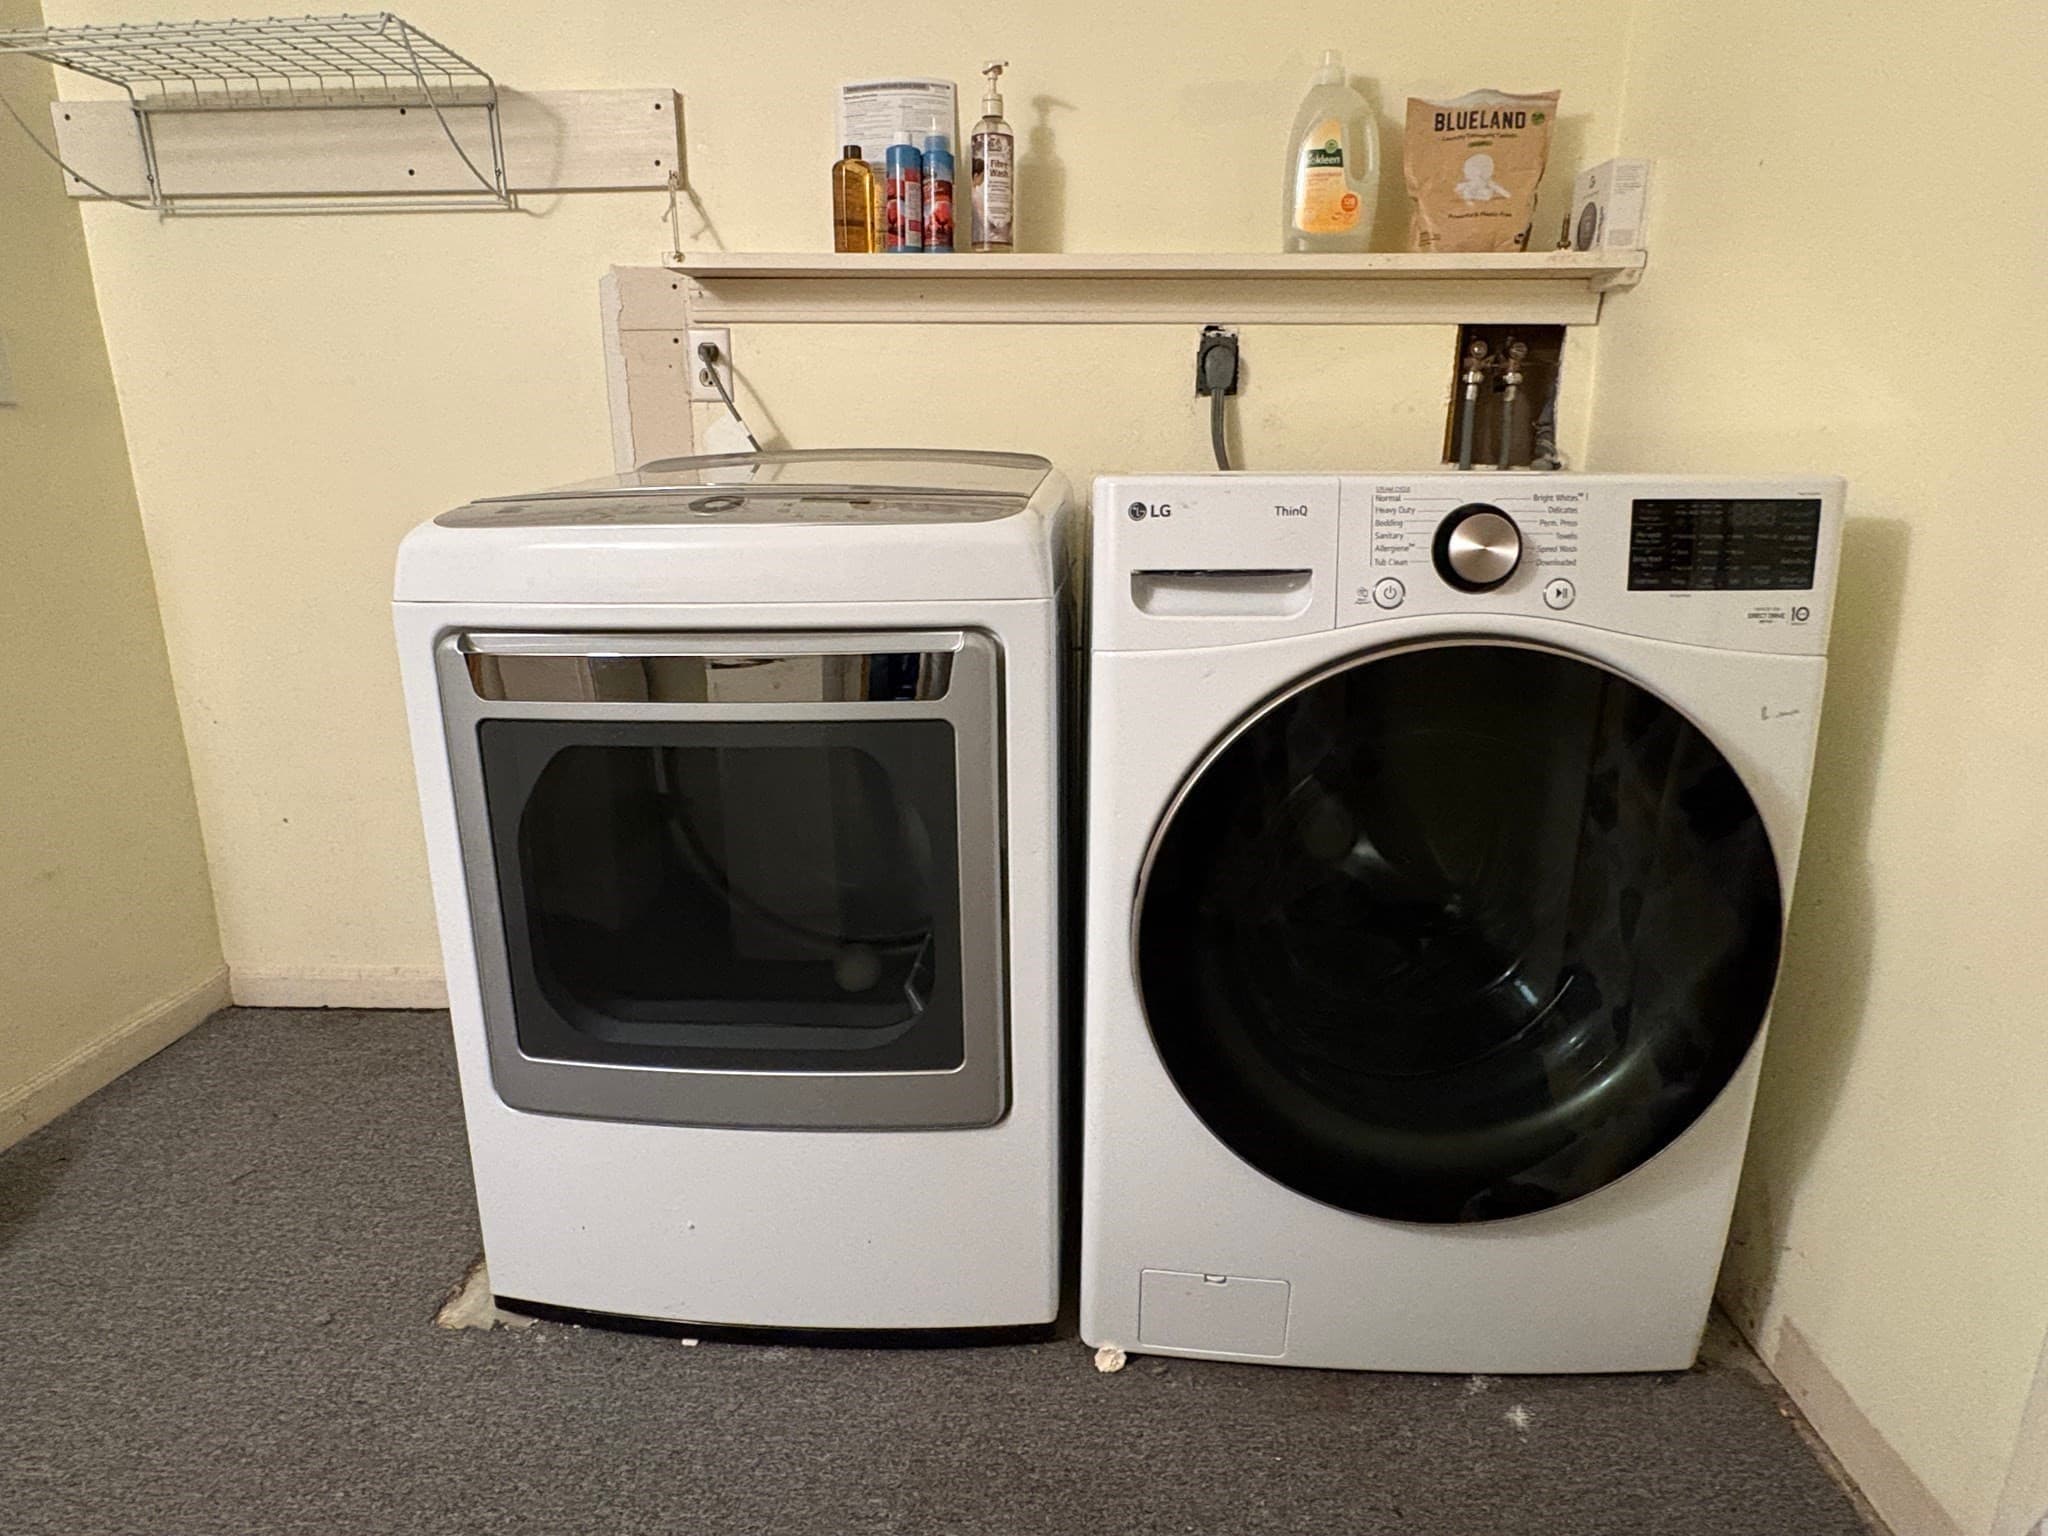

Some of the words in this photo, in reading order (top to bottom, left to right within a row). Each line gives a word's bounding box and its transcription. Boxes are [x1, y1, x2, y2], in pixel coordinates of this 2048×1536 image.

[1434, 110, 1526, 132] BLUELAND
[990, 168, 1009, 177] Wash
[1376, 494, 1401, 502] Normal
[1533, 493, 1554, 504] Bright
[1150, 503, 1172, 518] LG
[1274, 505, 1308, 517] ThinQ
[1375, 507, 1397, 515] Heavy
[1398, 506, 1416, 515] Duty
[1547, 505, 1578, 514] Delicates
[1375, 519, 1404, 529] Bedding
[1375, 531, 1404, 541] Sanitary
[1375, 558, 1387, 567] Tub
[1388, 558, 1409, 567] Clean
[1535, 558, 1577, 567] Downloaded
